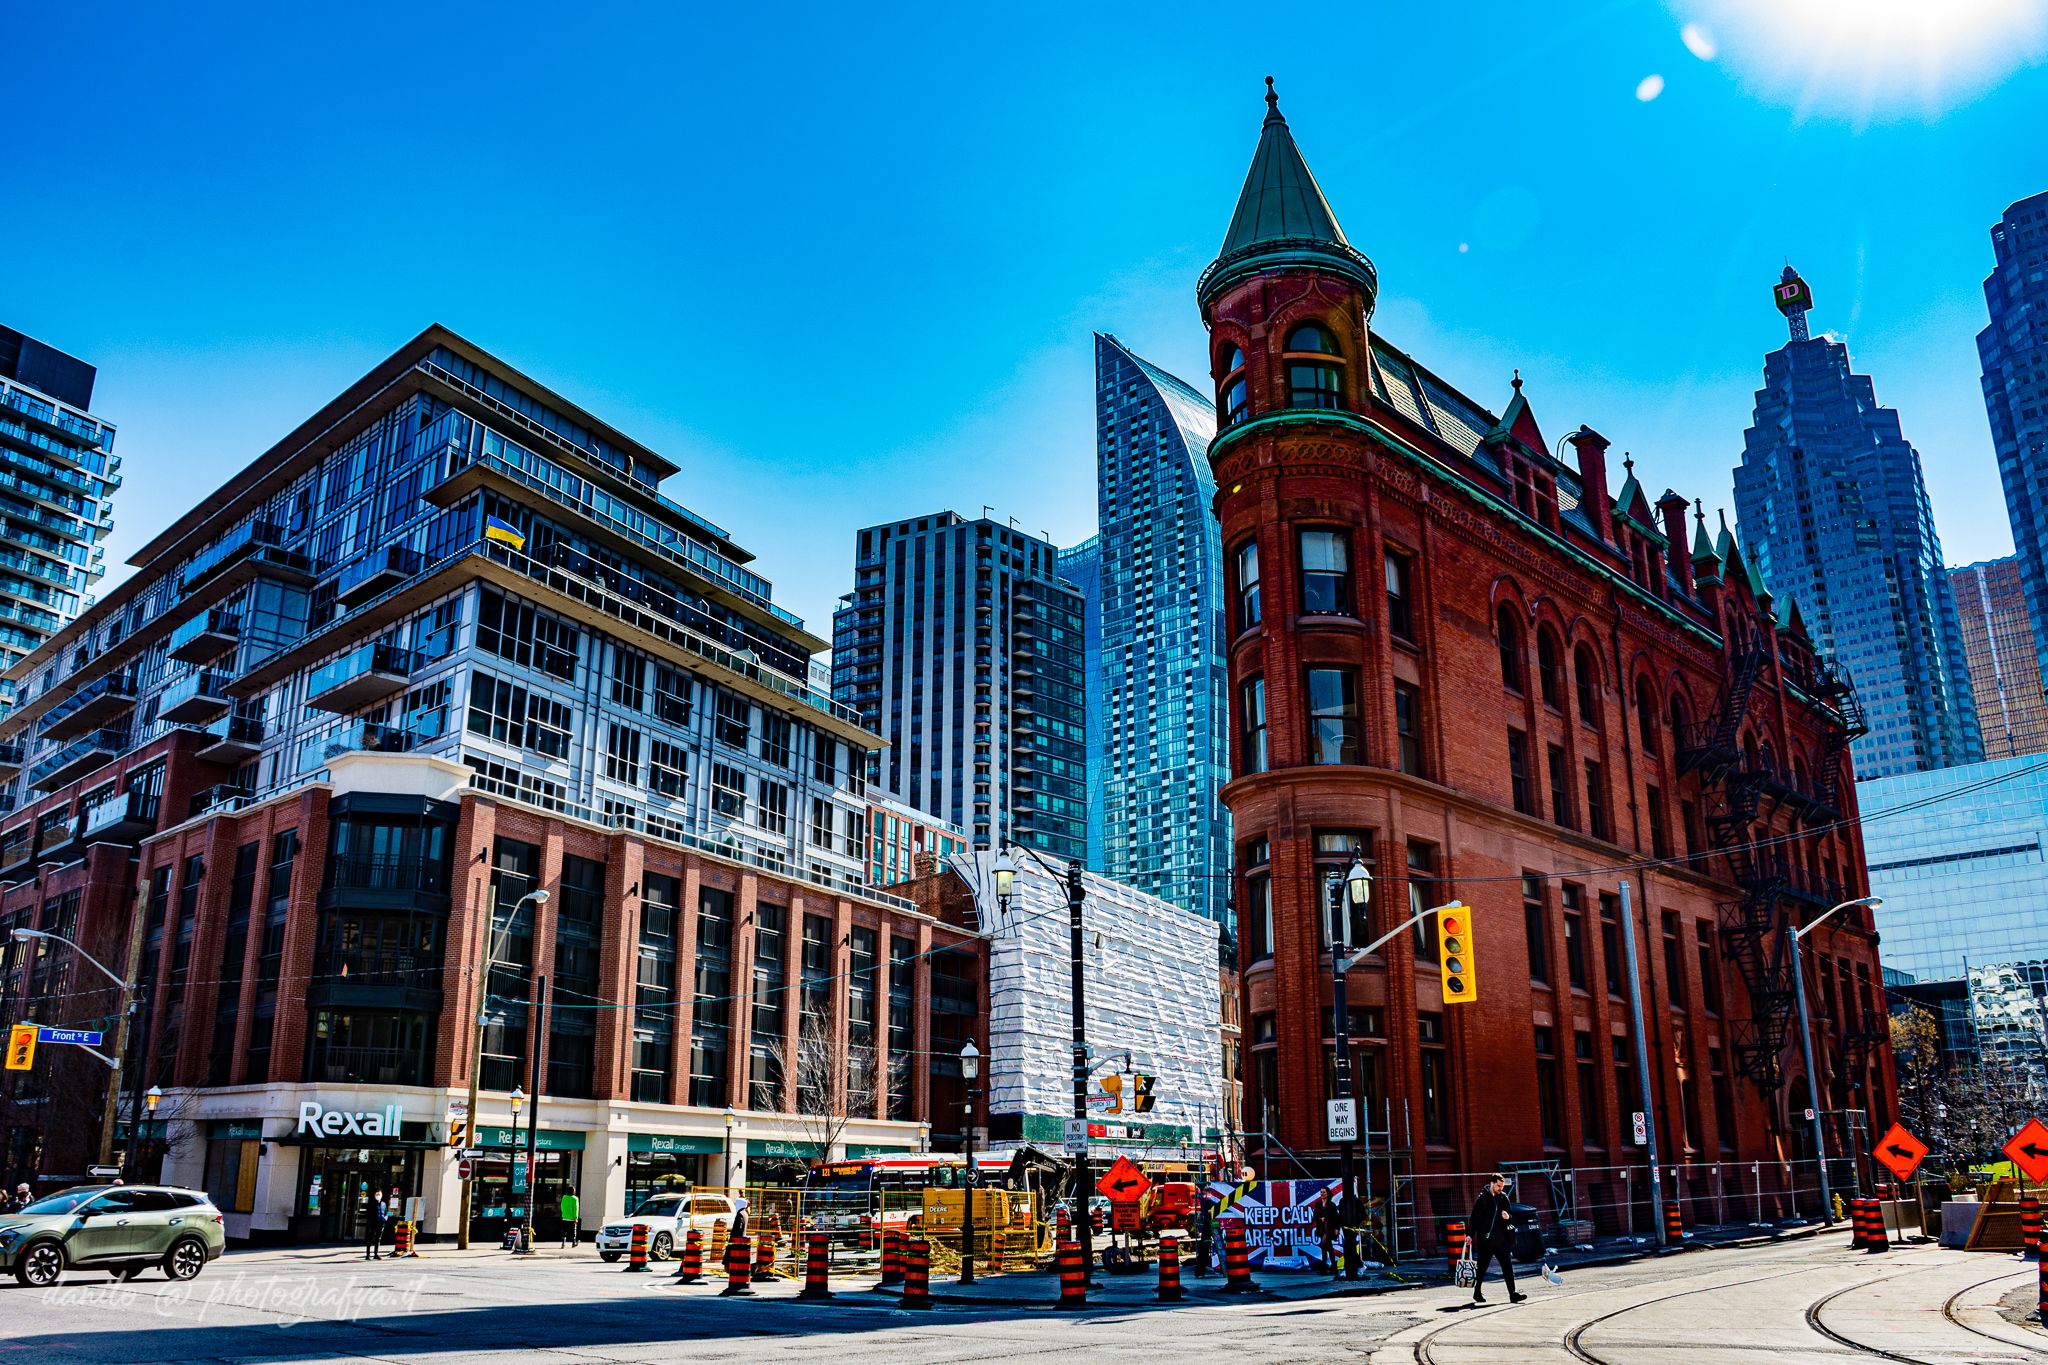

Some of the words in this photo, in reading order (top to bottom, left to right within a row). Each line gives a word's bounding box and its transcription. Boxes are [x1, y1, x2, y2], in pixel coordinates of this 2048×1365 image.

[1777, 283, 1799, 300] TD
[52, 1031, 75, 1040] Front
[83, 1033, 89, 1041] E
[1334, 1103, 1348, 1112] ONE
[298, 1101, 402, 1138] Rexall
[1335, 1115, 1348, 1124] WAY
[1071, 1122, 1081, 1132] NO
[1330, 1127, 1355, 1137] BEGINS
[651, 1137, 674, 1150] Rexall
[674, 1143, 696, 1151] Drugstore
[765, 1143, 785, 1154] Rexall
[821, 1168, 831, 1177] 121
[1244, 1206, 1279, 1225] KEEP
[1245, 1228, 1271, 1247] ARE
[1273, 1228, 1310, 1247] STILL
